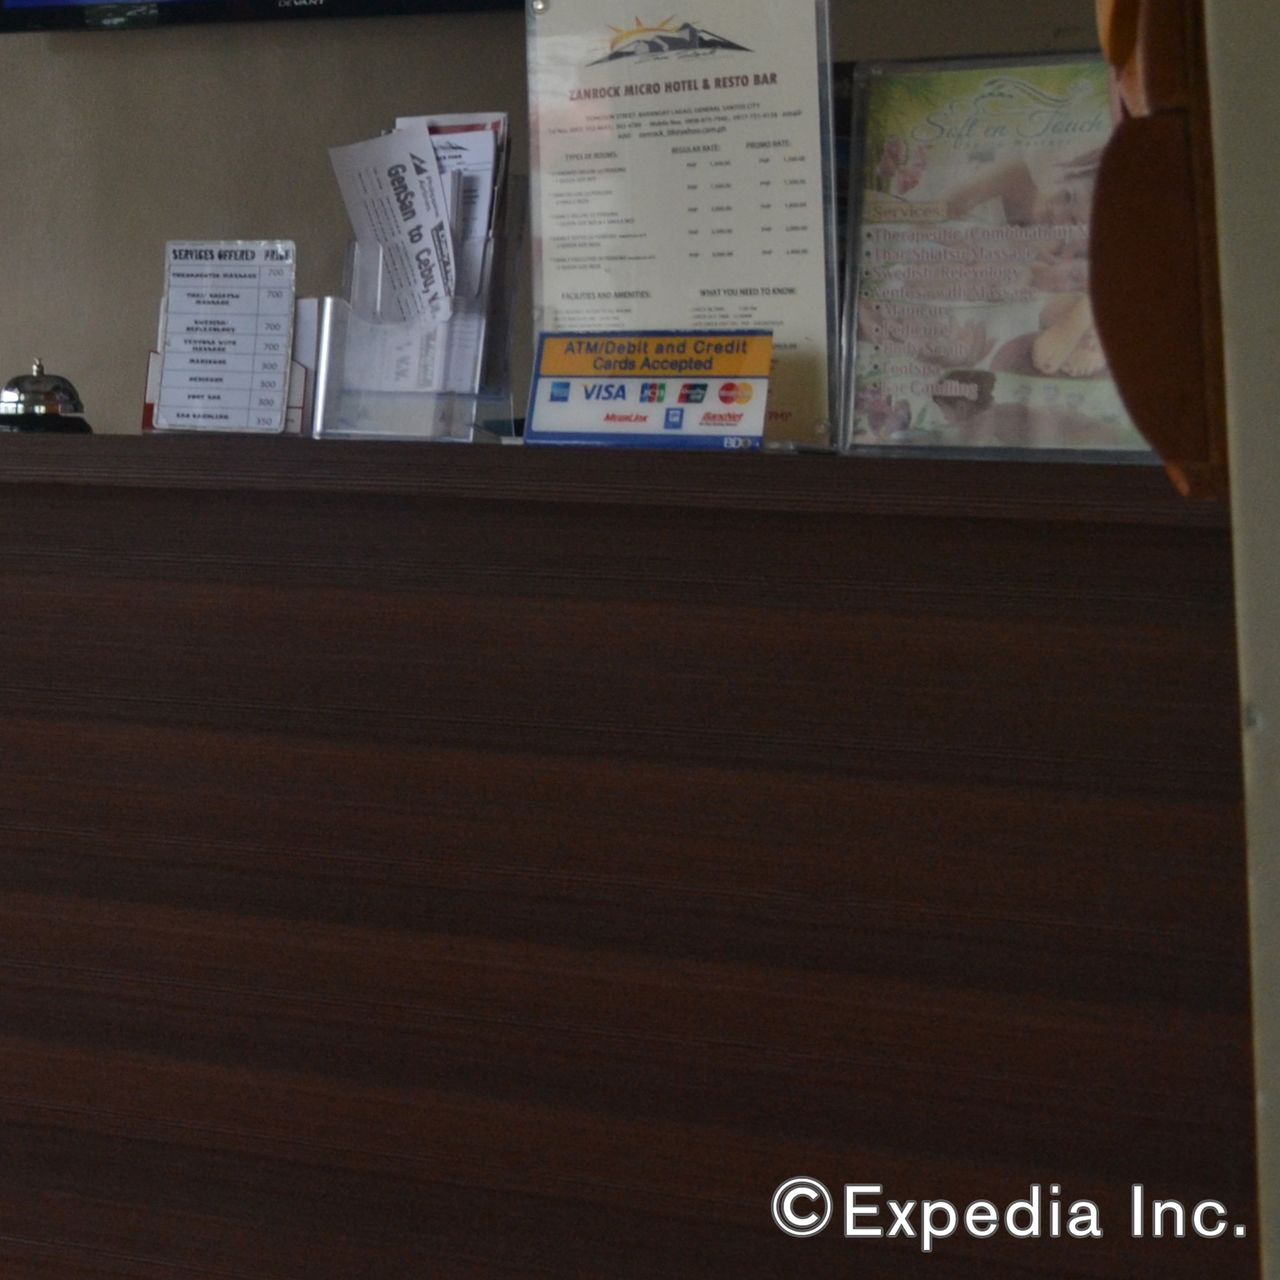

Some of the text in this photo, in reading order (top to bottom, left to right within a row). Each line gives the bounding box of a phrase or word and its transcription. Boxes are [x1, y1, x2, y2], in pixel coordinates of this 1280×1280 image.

[569, 72, 778, 102] ZANROCK MICRO HOTEL & RESTO BAR
[911, 105, 979, 150] Soft
[1016, 110, 1105, 139] Touch
[872, 204, 942, 218] Services
[387, 163, 436, 294] GenSan to Cebu,
[172, 248, 291, 261] SERVICES OFFERED PRICE
[267, 269, 284, 277] 700
[266, 290, 283, 299] 700
[264, 323, 282, 332] 700
[263, 342, 280, 351] 700
[564, 340, 748, 355] ATM/Debit and Credit
[593, 357, 714, 372] Cards Accepted
[583, 384, 627, 401] VISA
